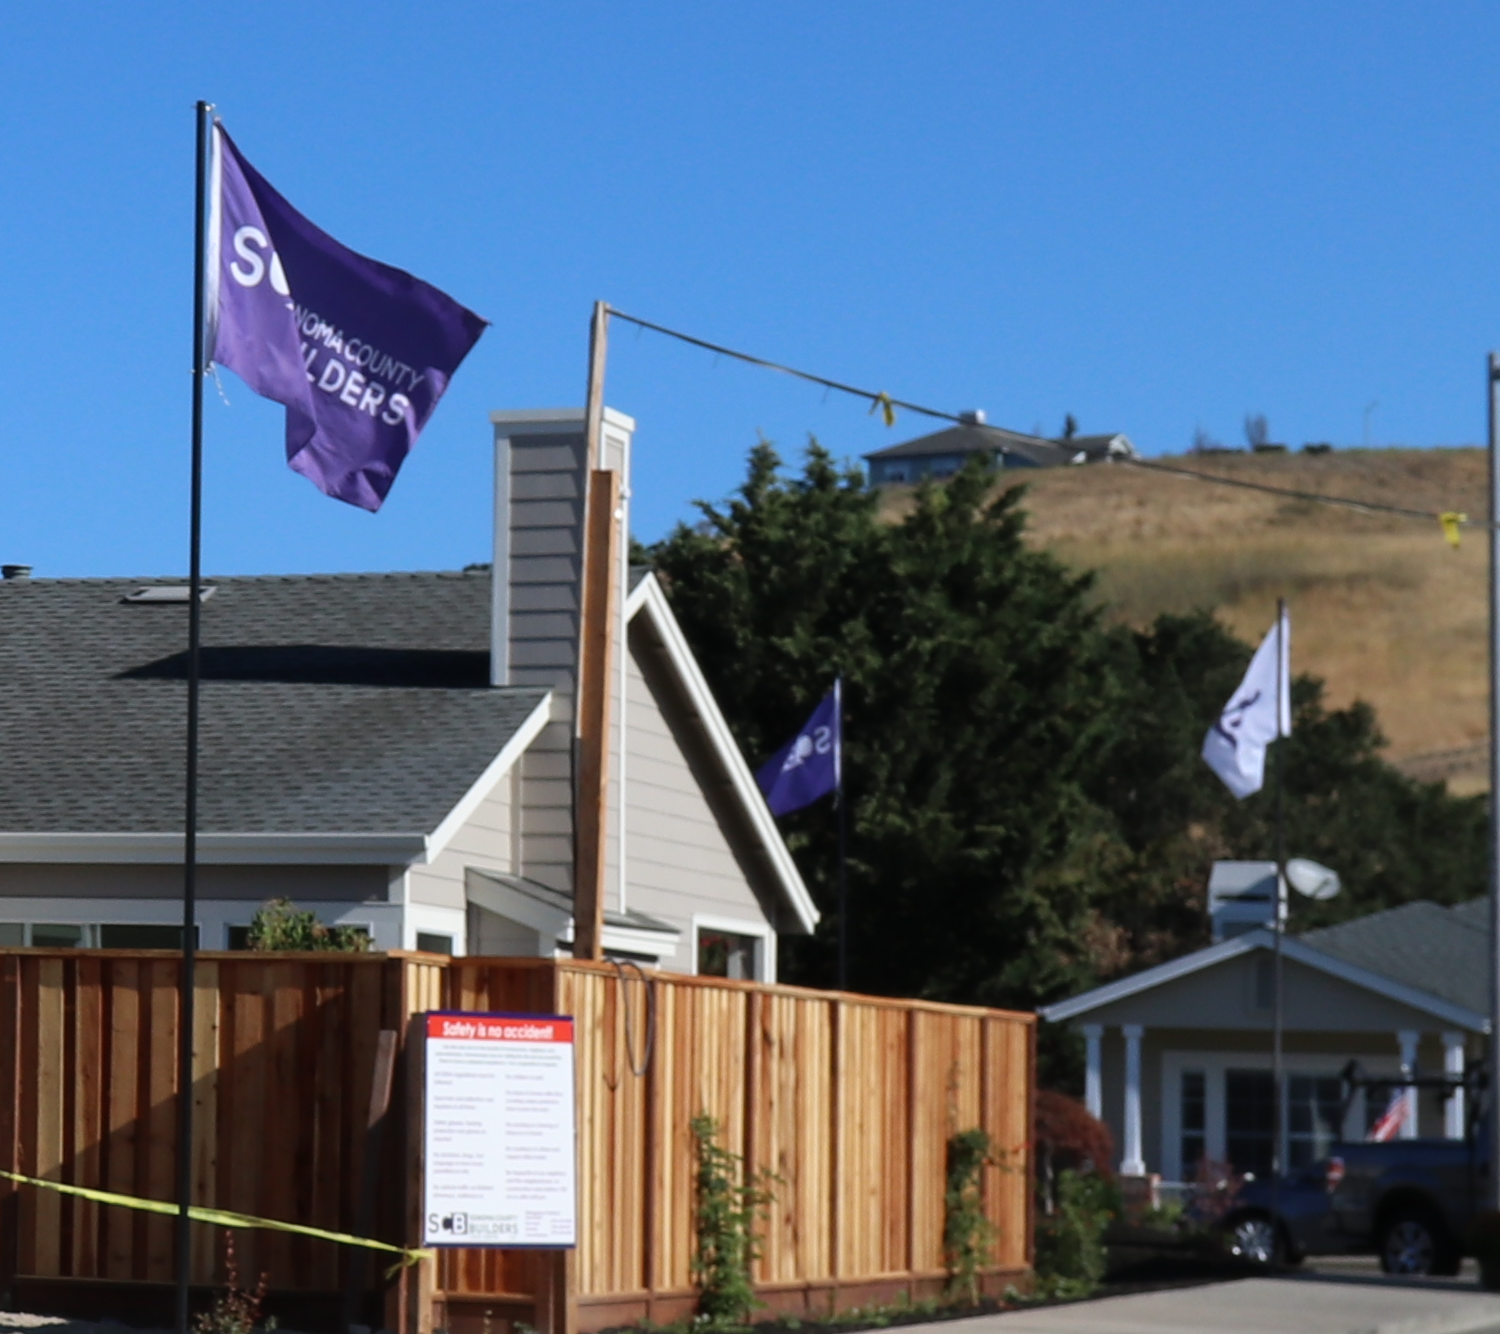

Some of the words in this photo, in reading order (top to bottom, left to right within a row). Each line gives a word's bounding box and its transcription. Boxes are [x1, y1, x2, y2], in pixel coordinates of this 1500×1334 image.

[344, 338, 425, 392] COUNTY
[442, 1021, 476, 1039] Safety
[478, 1022, 487, 1037] is
[488, 1025, 502, 1037] no
